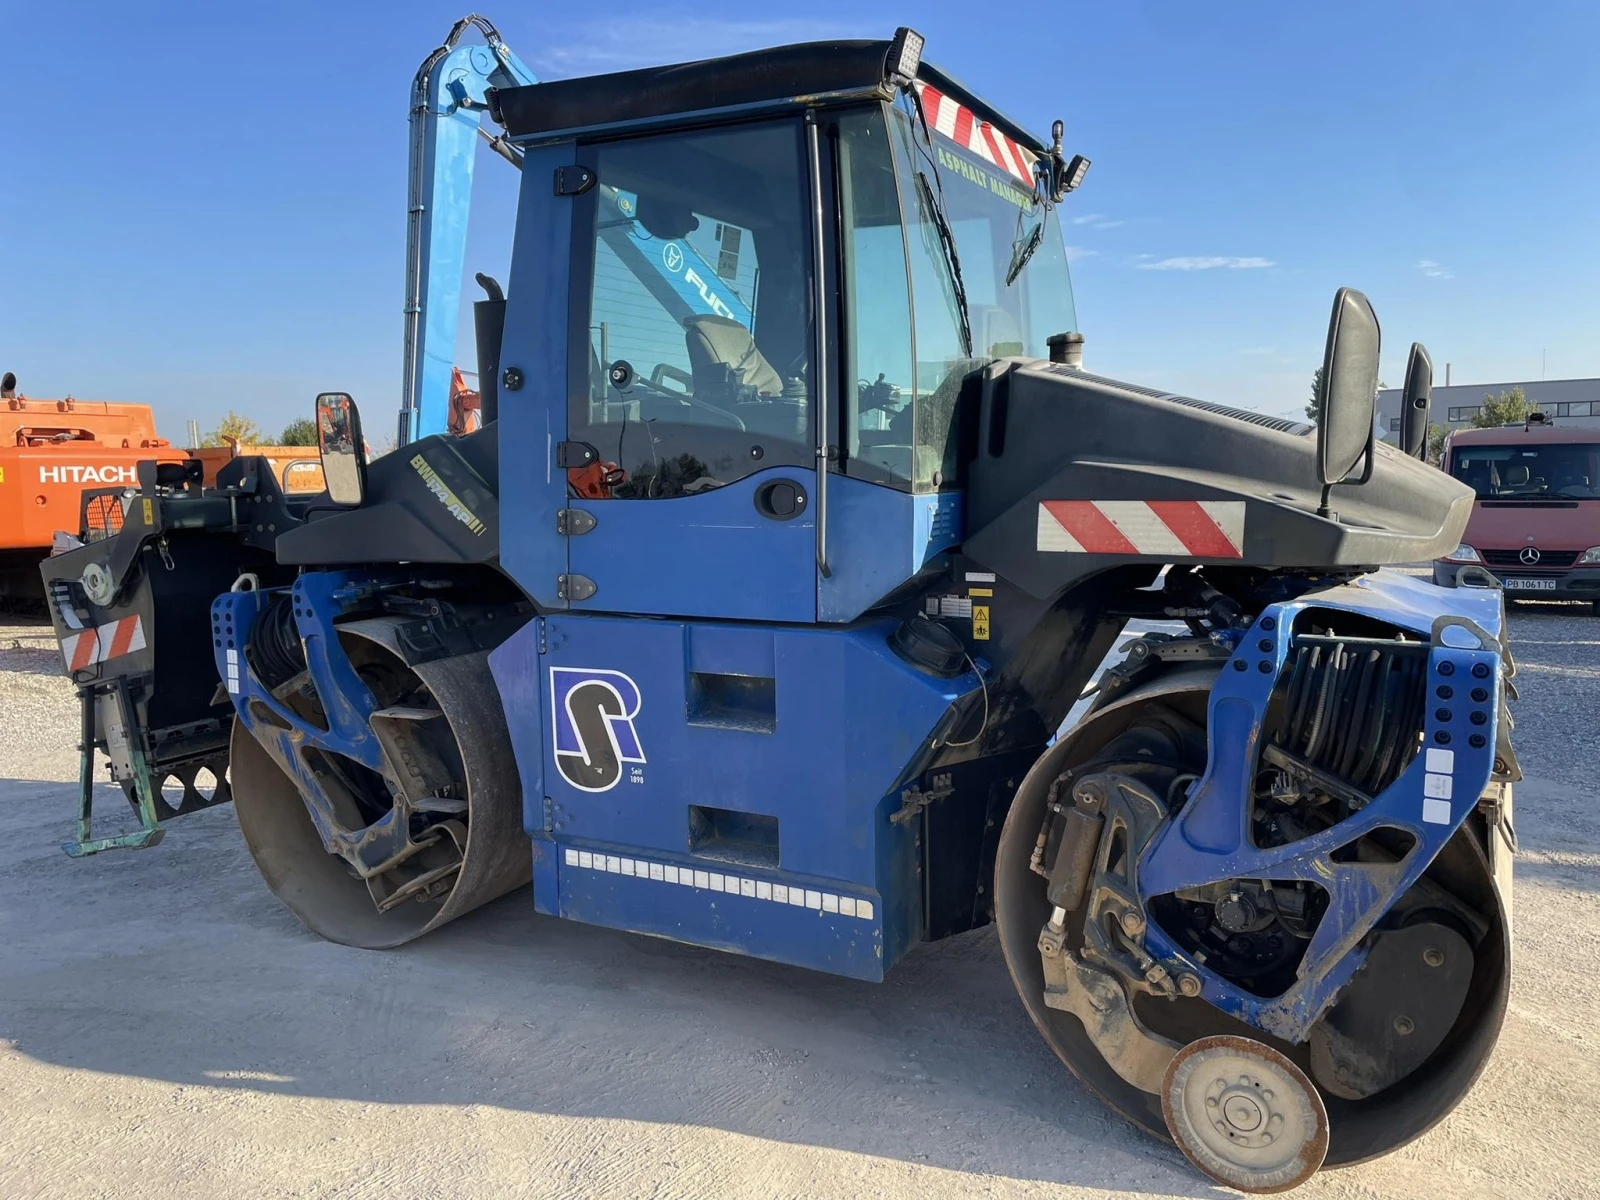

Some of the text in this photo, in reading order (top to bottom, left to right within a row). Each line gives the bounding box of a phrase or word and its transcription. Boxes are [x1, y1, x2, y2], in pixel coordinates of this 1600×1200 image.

[938, 147, 987, 189] ASPHALT
[685, 268, 736, 321] FUC
[39, 465, 136, 483] HITACH
[1507, 580, 1555, 589] PB 1061 TC
[630, 775, 644, 784] 1898
